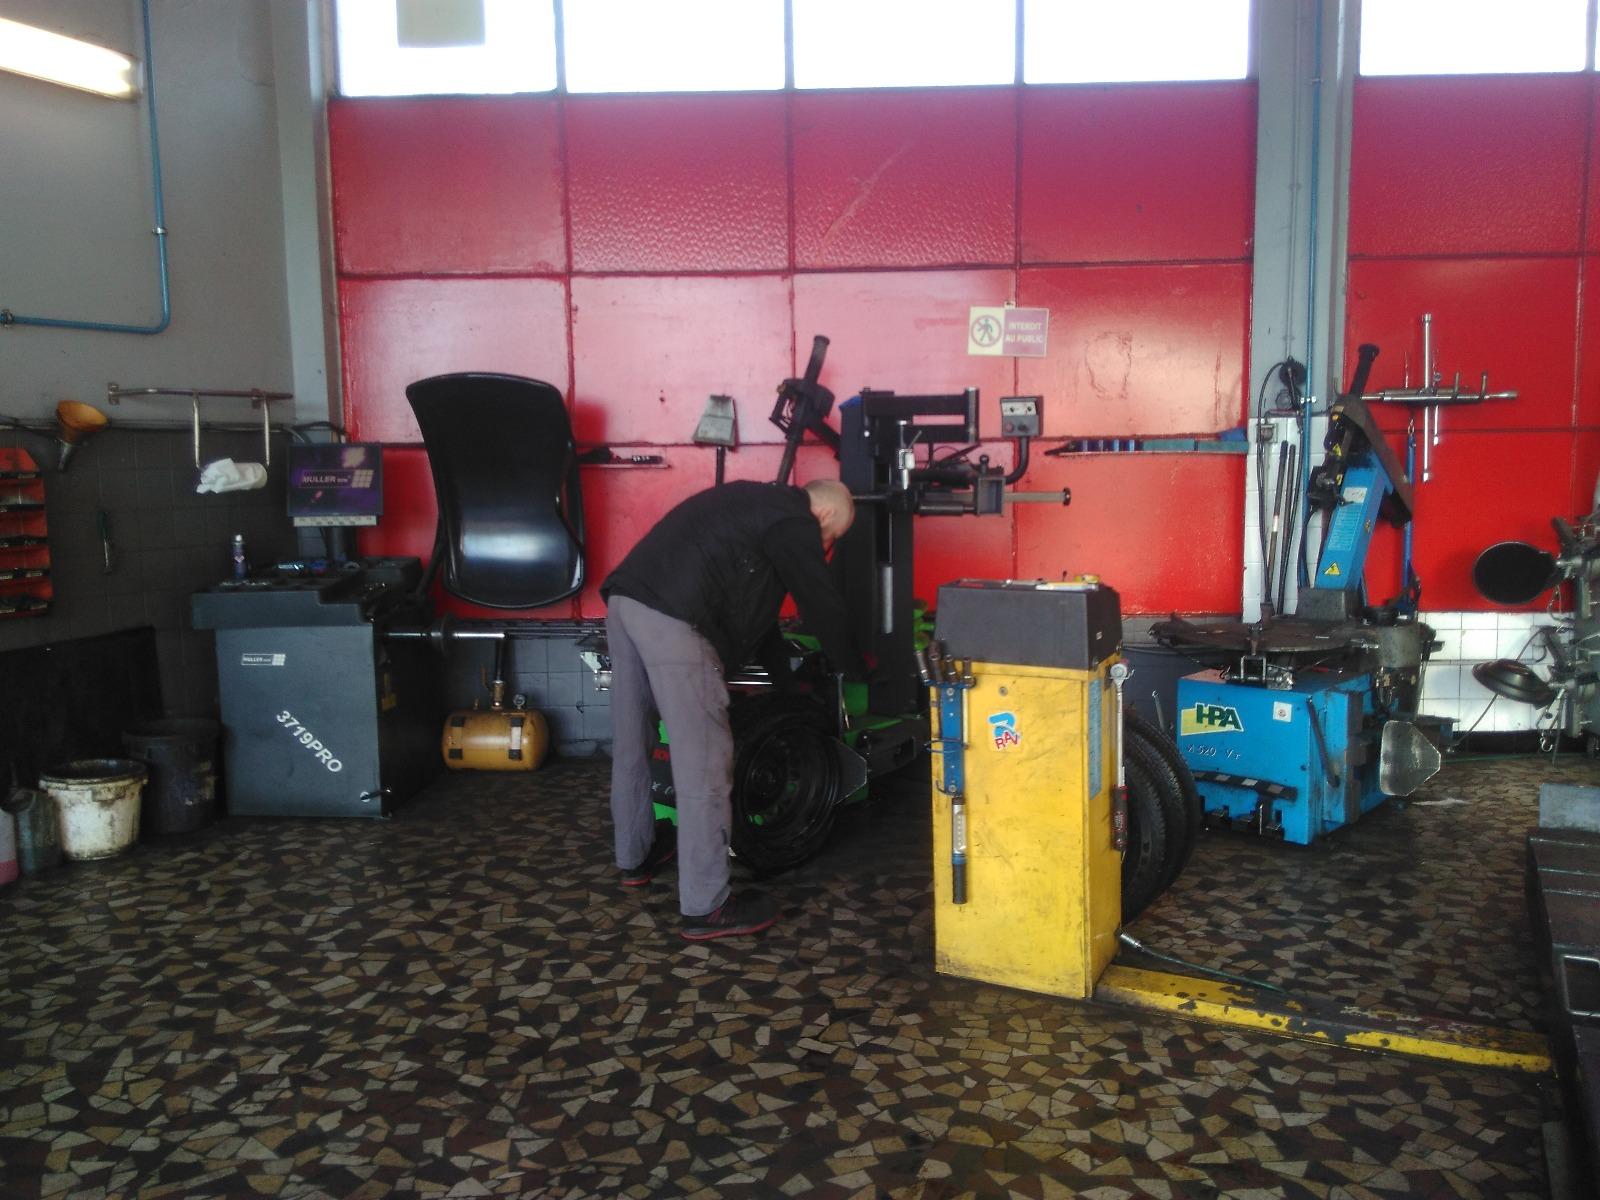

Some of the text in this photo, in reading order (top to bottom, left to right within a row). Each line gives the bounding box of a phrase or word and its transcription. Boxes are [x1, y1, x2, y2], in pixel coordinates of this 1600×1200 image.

[1008, 321, 1041, 330] INTERDIT
[1005, 333, 1043, 343] AU PUBLIC
[303, 475, 336, 483] MULLER
[1195, 702, 1244, 732] HPA
[276, 710, 343, 772] 3719PRO
[994, 730, 1018, 749] RAV
